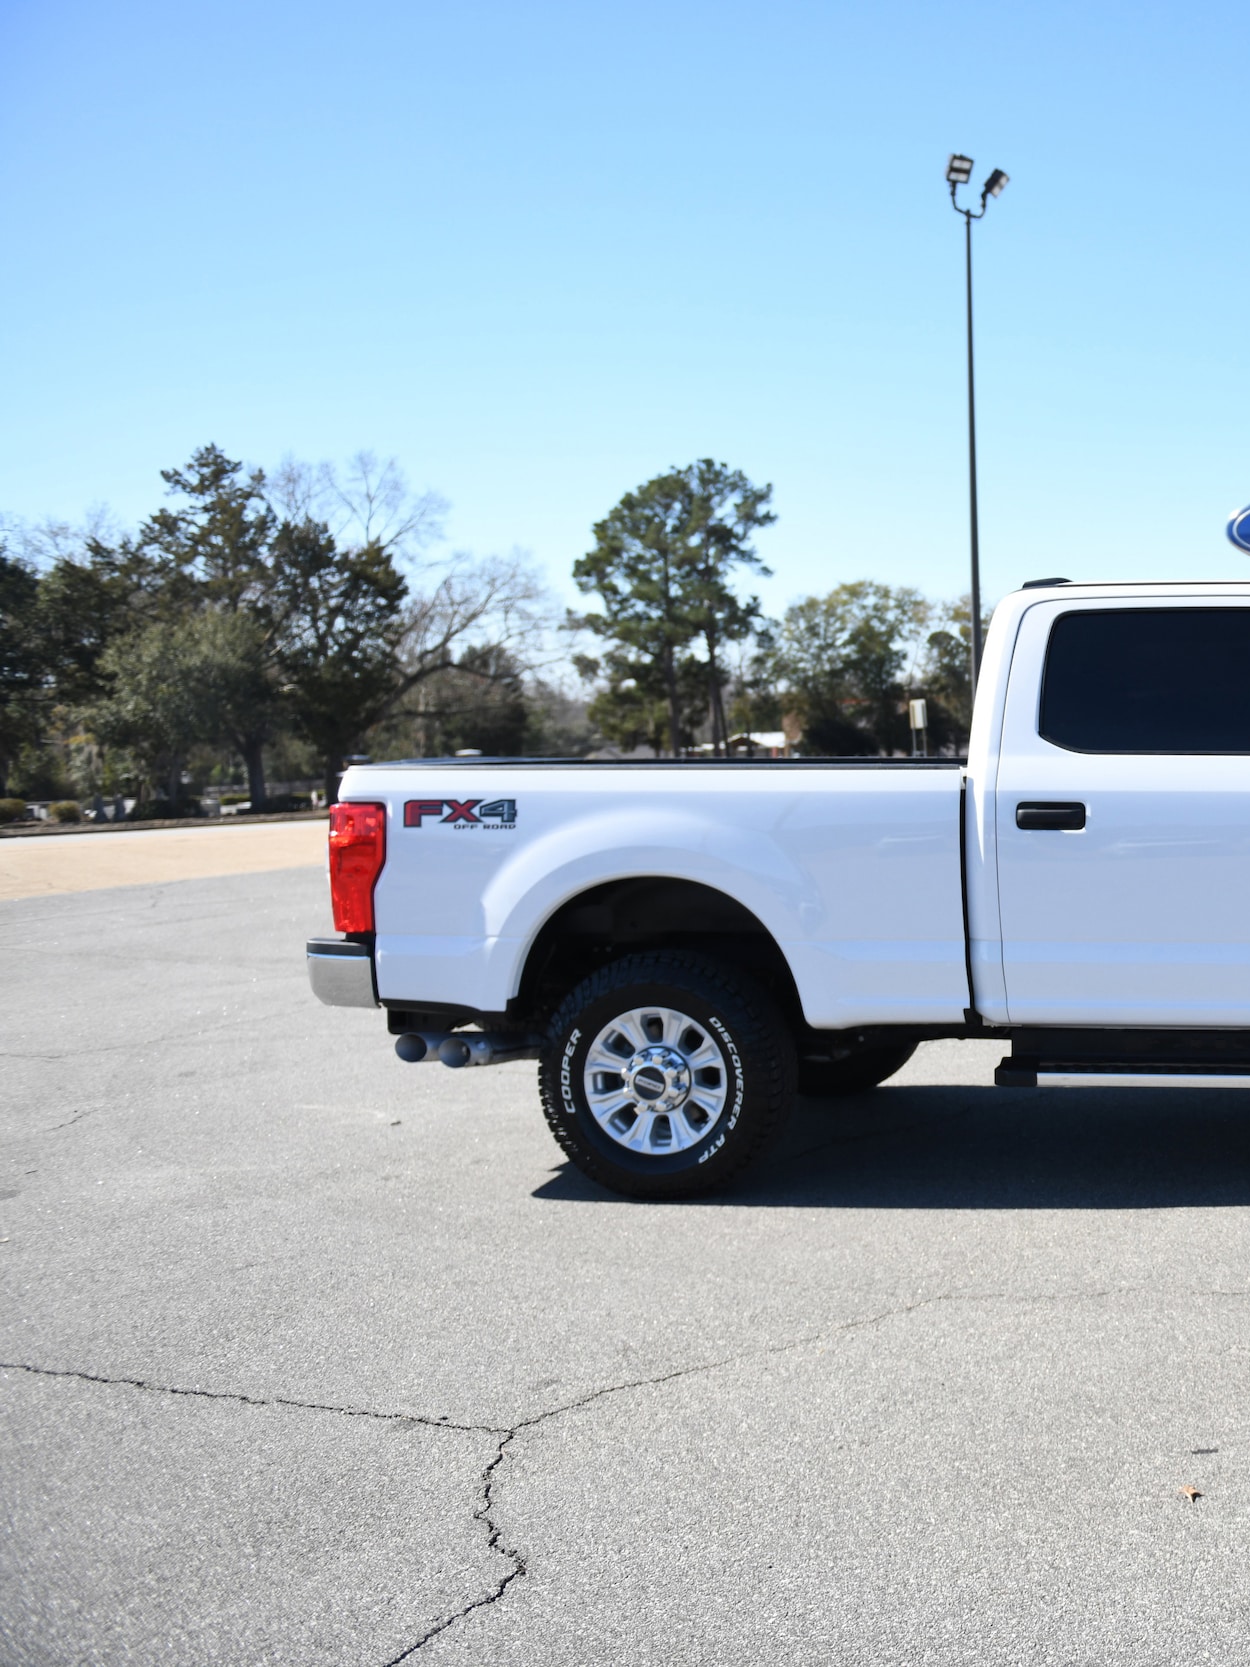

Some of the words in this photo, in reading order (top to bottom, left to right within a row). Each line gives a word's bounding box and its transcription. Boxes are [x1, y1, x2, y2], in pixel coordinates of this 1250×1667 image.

[403, 799, 517, 828] FX4
[561, 1028, 582, 1114] COOPER
[709, 1016, 744, 1130] DISCOVERER
[698, 1133, 725, 1163] ATP
